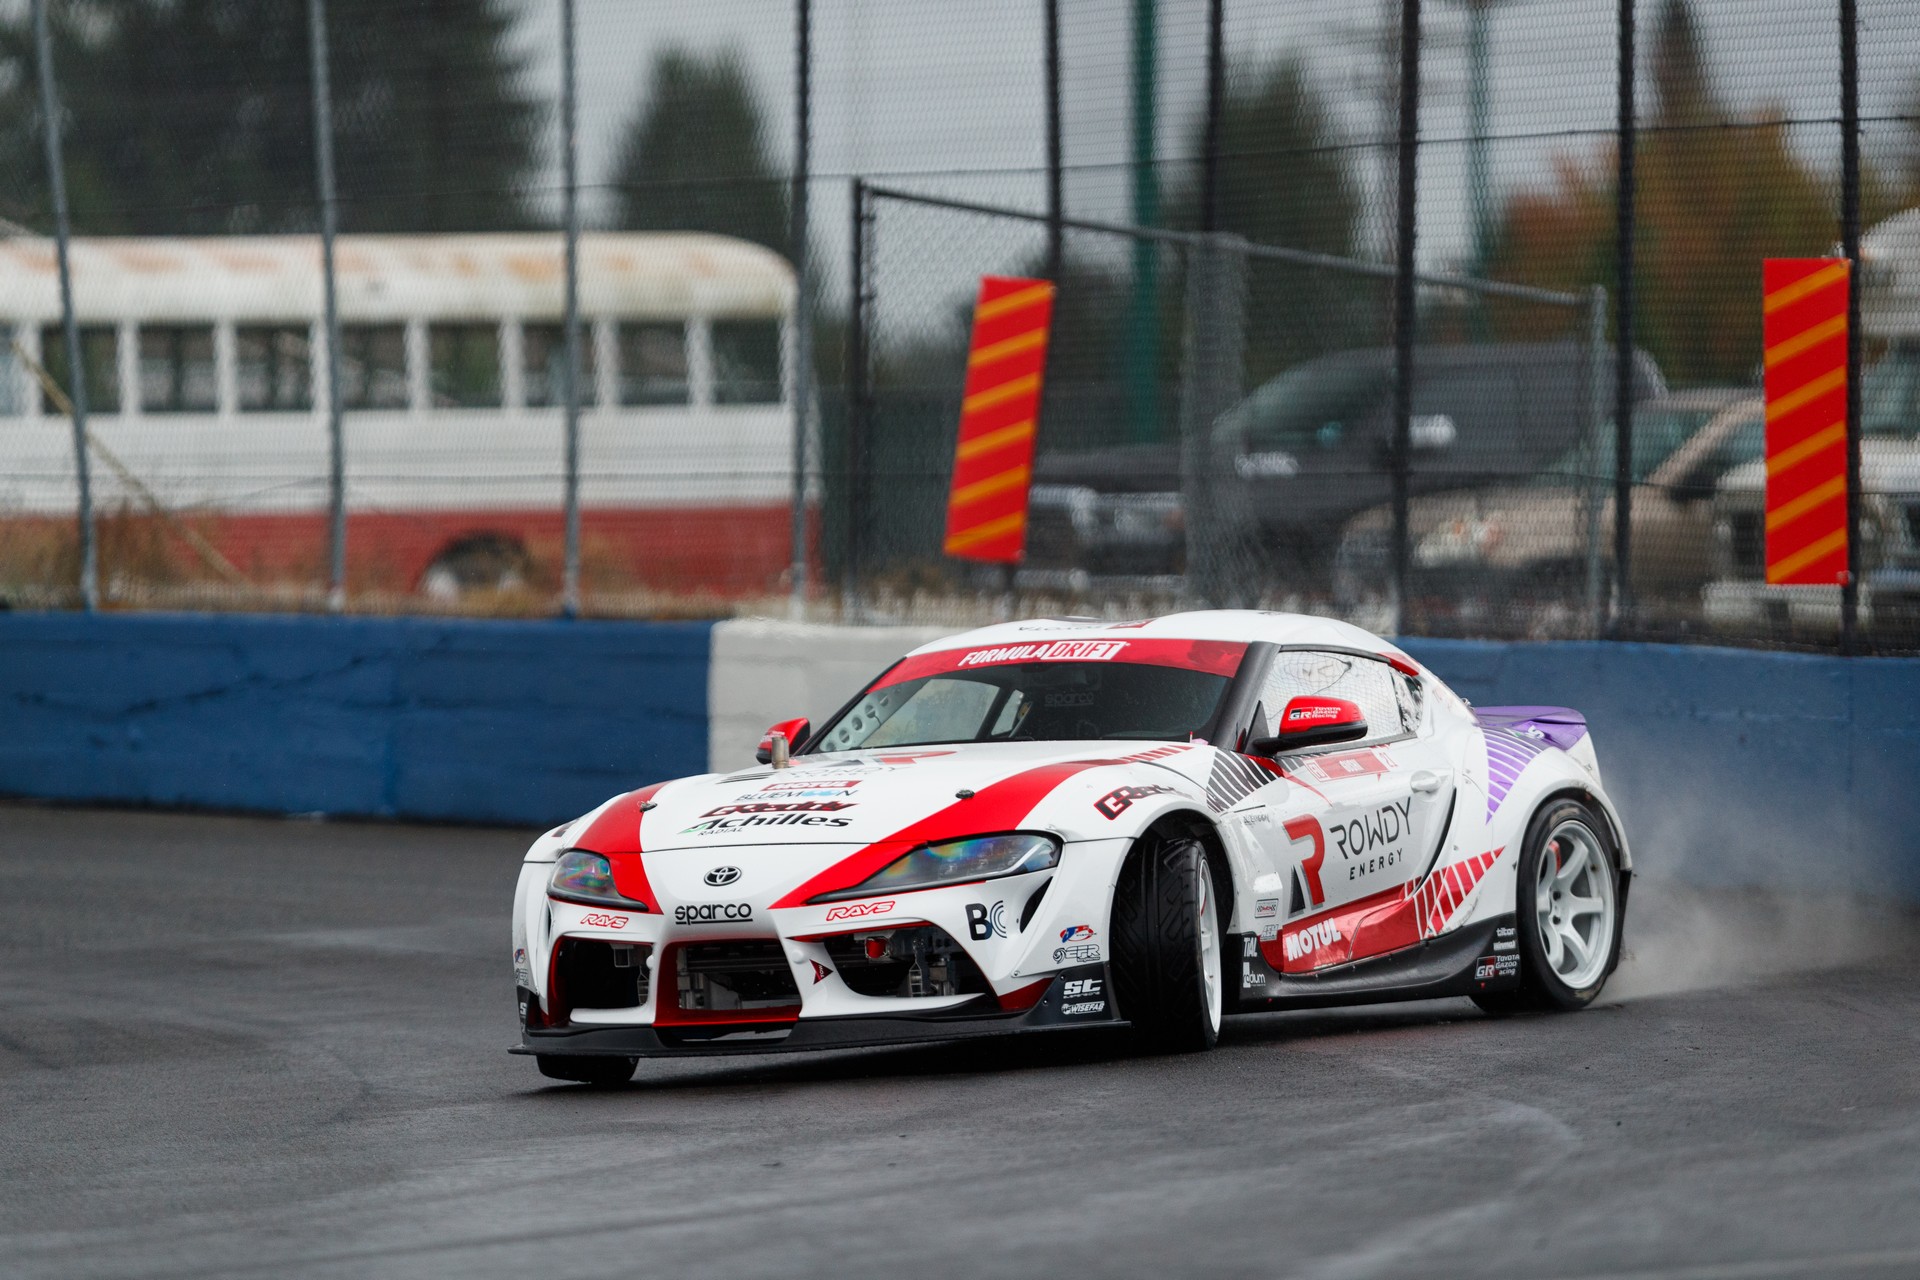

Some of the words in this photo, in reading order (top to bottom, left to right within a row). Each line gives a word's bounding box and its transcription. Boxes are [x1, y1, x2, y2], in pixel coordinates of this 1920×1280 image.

[958, 643, 1052, 667] FORMULA
[1042, 640, 1127, 661] DRIFT
[1290, 711, 1312, 720] GR
[771, 781, 851, 791] MOTUL
[736, 790, 859, 801] BLUEMOON
[678, 813, 853, 835] Achilles
[698, 826, 743, 836] RADIAL
[1329, 796, 1412, 860] ROWDY
[1348, 848, 1403, 881] ENERGY
[674, 902, 753, 926] sparco
[826, 901, 896, 921] RAYS
[580, 913, 629, 929] RAYS
[1285, 918, 1342, 961] MOTUL
[1065, 944, 1100, 960] EFR
[1496, 954, 1520, 962] TOYOTA
[1476, 964, 1495, 977] GR
[1495, 961, 1517, 969] GAZOO
